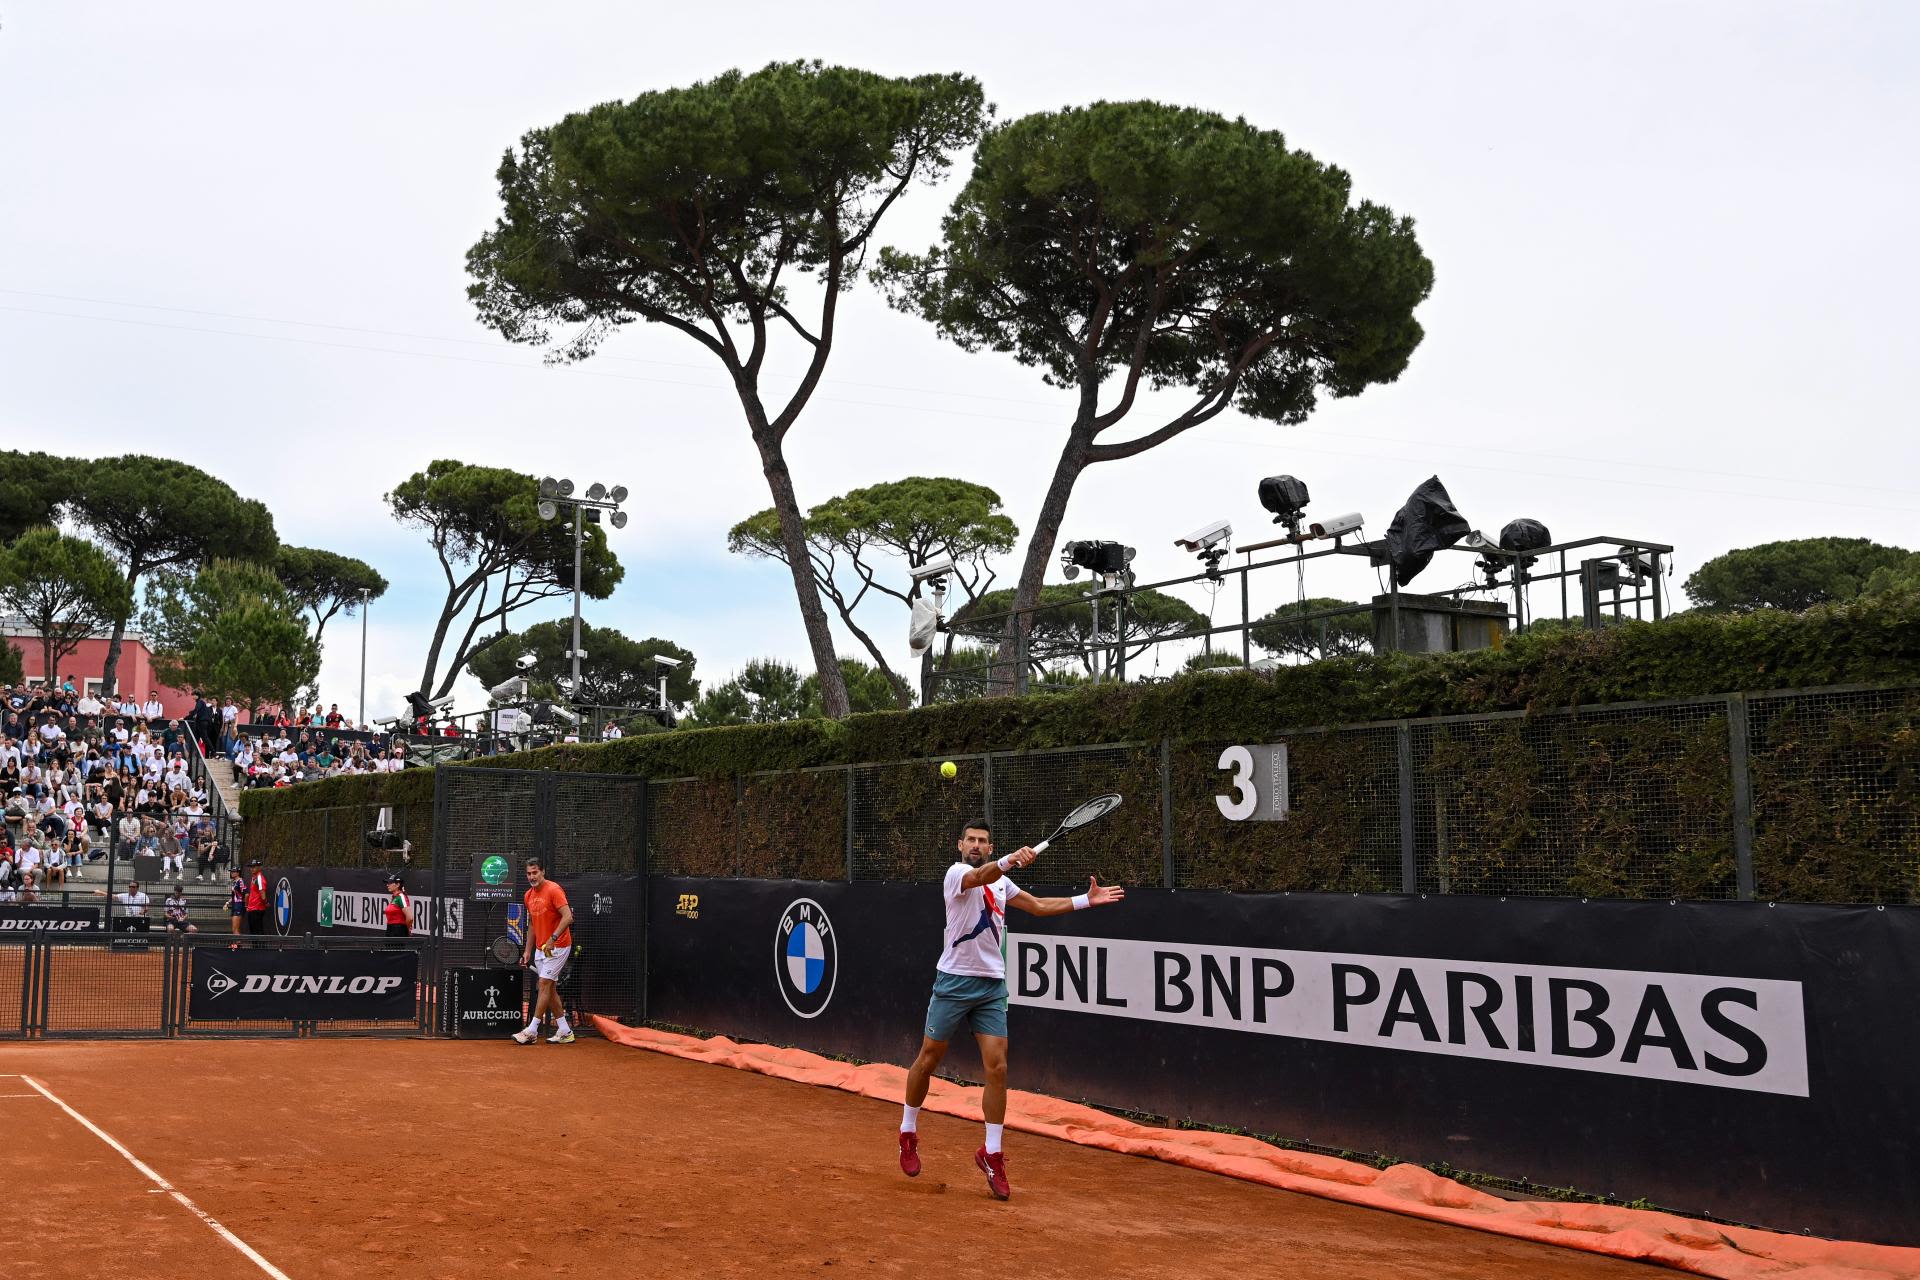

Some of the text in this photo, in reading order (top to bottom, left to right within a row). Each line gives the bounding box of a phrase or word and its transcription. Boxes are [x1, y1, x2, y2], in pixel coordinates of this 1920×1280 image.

[1215, 745, 1257, 821] 3
[335, 894, 357, 923] BNL
[676, 894, 698, 911] ATP
[0, 919, 91, 931] DUNLOP
[782, 904, 830, 937] BMW
[239, 974, 402, 995] DUNLOP
[462, 1010, 522, 1020] AURICCHIO
[1017, 941, 1769, 1078] BNL BNP PARIBAS
